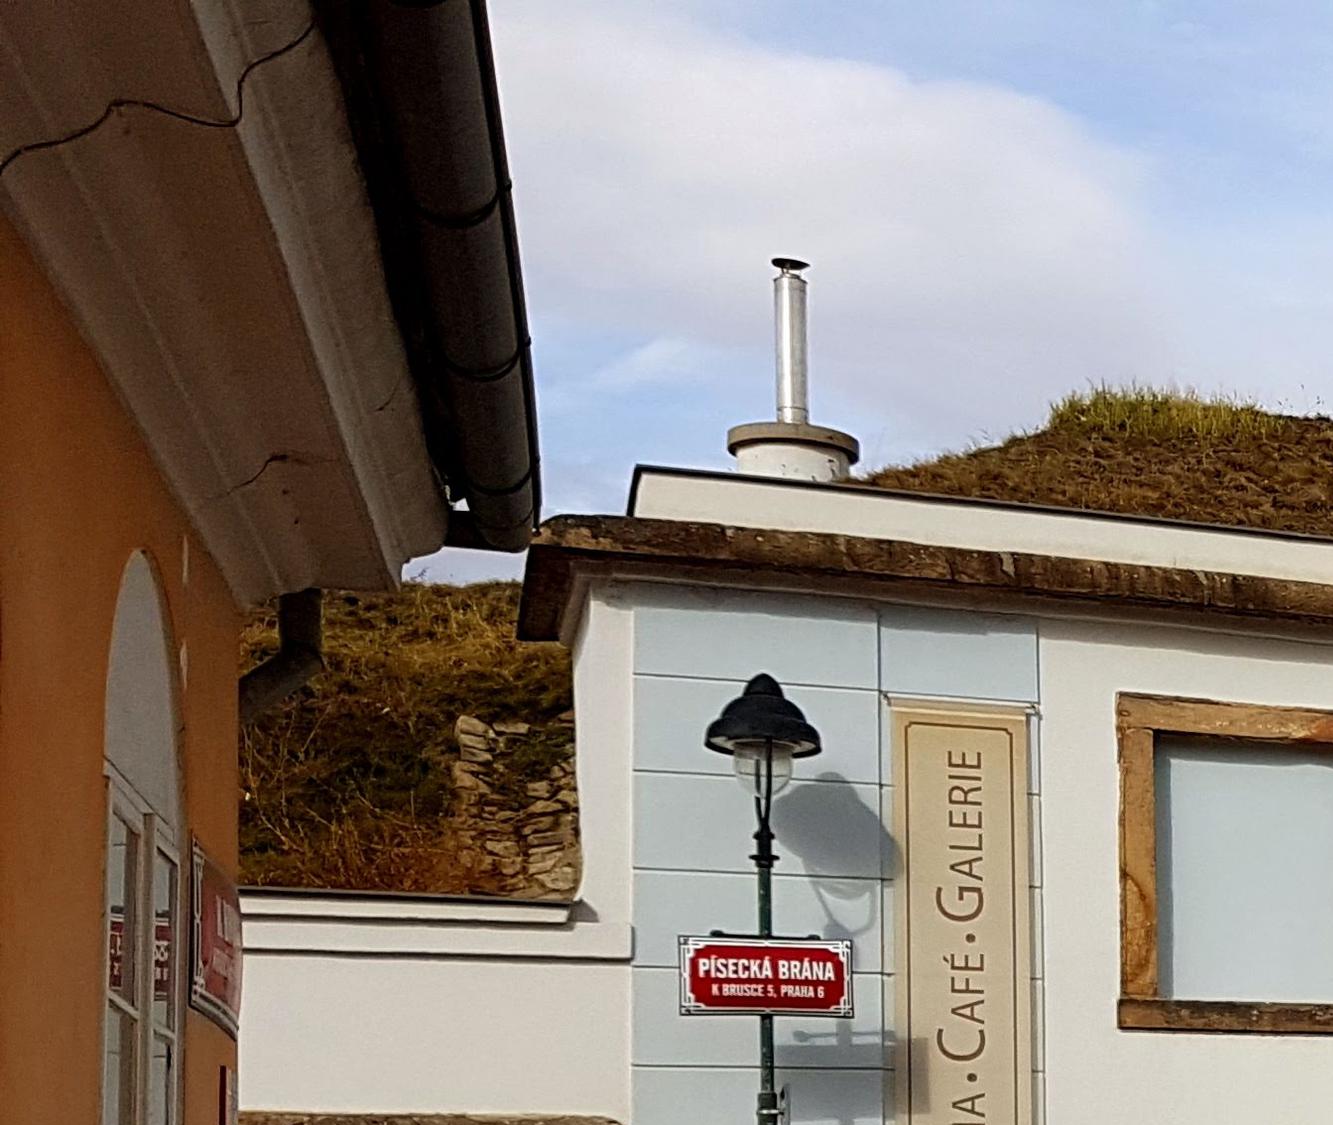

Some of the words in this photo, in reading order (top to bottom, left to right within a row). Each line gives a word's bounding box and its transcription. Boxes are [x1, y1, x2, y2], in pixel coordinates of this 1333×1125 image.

[935, 750, 985, 923] GALERIE
[698, 954, 773, 979] PÍSECKÁ
[778, 957, 836, 981] BRÁNA
[712, 984, 720, 996] K
[722, 984, 765, 997] BRUSCE
[780, 985, 815, 998] PRAHA
[817, 986, 825, 998] 6
[936, 952, 986, 1062] CAFÉ
